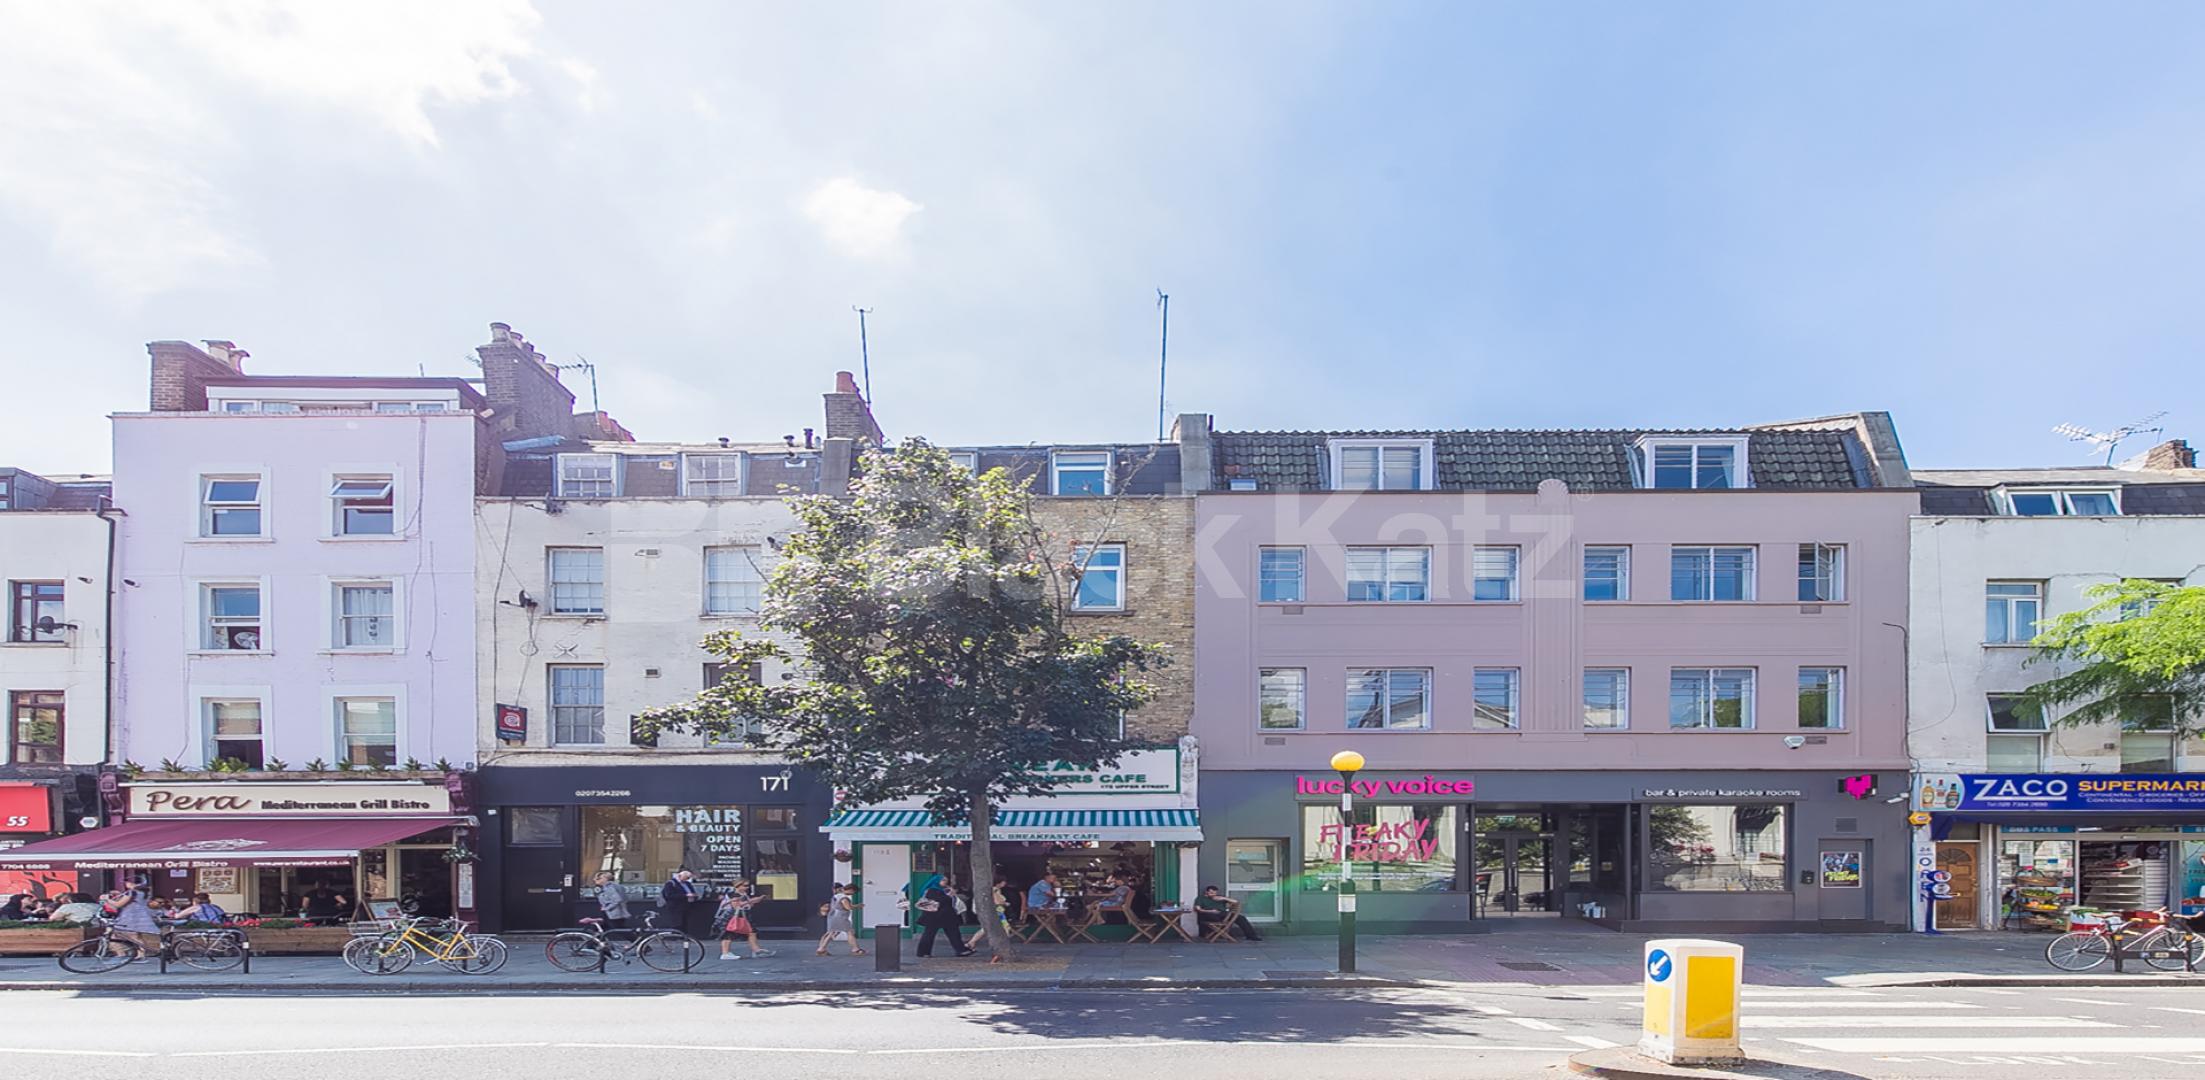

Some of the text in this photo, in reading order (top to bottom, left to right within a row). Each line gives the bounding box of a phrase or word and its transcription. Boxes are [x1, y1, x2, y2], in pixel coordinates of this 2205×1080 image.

[760, 776, 790, 791] 171
[1099, 774, 1146, 783] CAFE
[1383, 775, 1474, 795] voice
[1973, 779, 2068, 800] ZACO
[1678, 789, 1717, 798] private
[146, 790, 431, 812] Pera Mediterranean Grill Bistro
[676, 809, 741, 823] HAIR
[6, 816, 29, 827] 55
[676, 825, 741, 833] & BEAUTY
[706, 835, 741, 843] OPEN
[701, 844, 741, 852] 7 DAYS
[74, 861, 162, 869] Mediterranean
